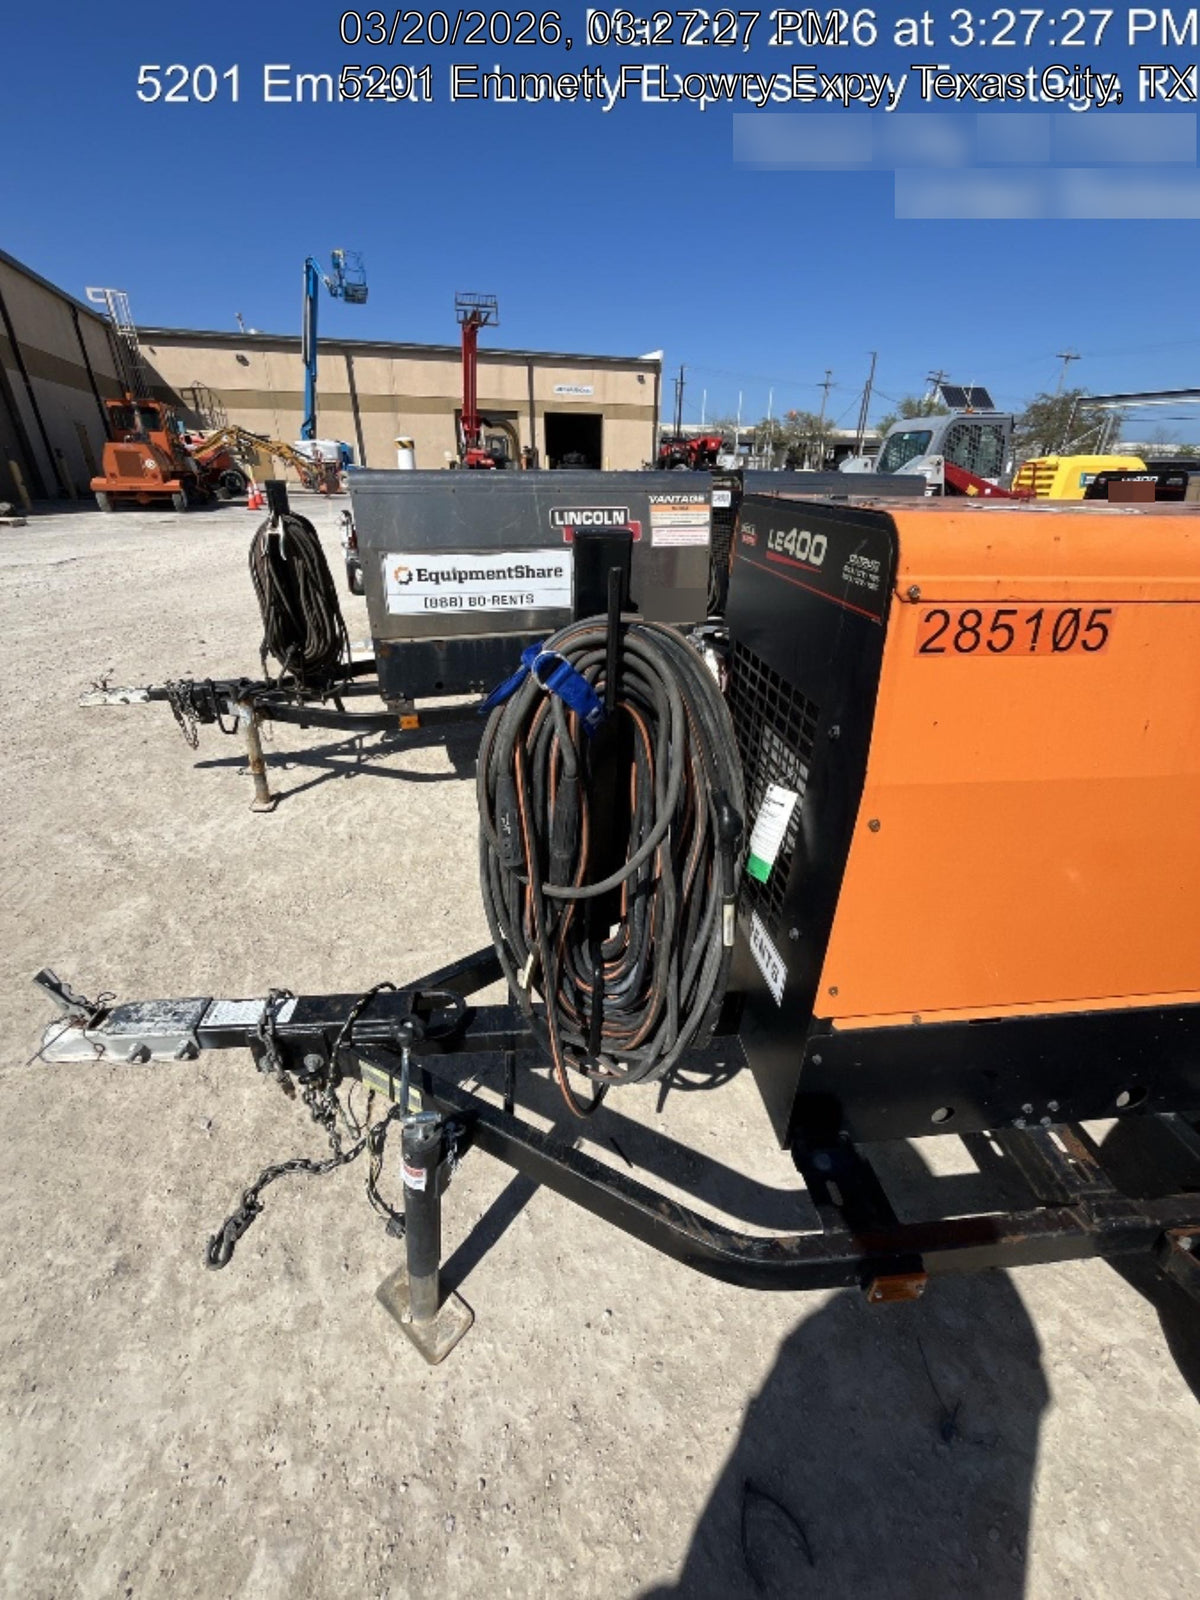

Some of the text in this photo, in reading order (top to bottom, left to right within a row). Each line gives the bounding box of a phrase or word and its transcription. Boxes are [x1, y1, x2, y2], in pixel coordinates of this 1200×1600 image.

[554, 510, 625, 526] LINCOLN
[767, 527, 828, 567] LE400
[415, 564, 564, 585] EquipmentShare
[918, 608, 1113, 654] 285105
